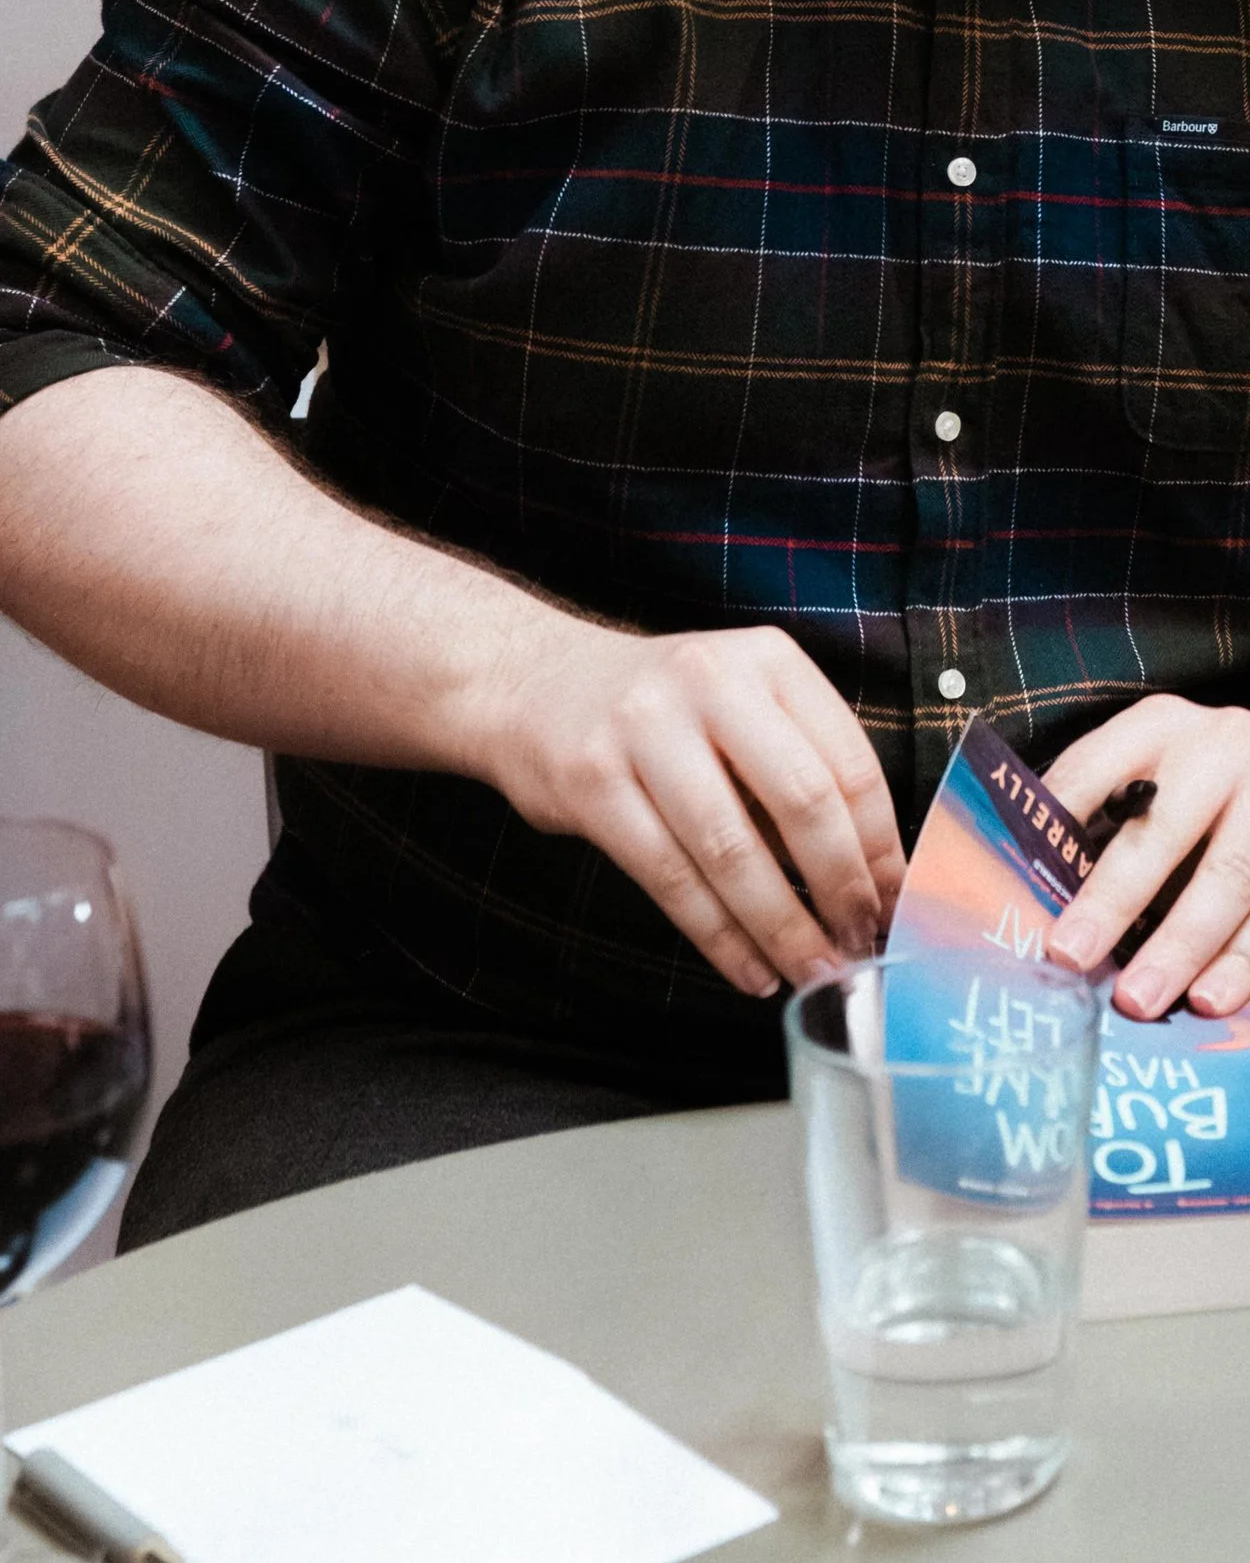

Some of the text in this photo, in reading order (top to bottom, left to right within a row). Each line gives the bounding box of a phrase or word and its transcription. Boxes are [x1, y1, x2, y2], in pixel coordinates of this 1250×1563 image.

[1162, 120, 1208, 133] Barbour
[990, 761, 1093, 879] ARRELLY
[1098, 1050, 1200, 1091] HAS
